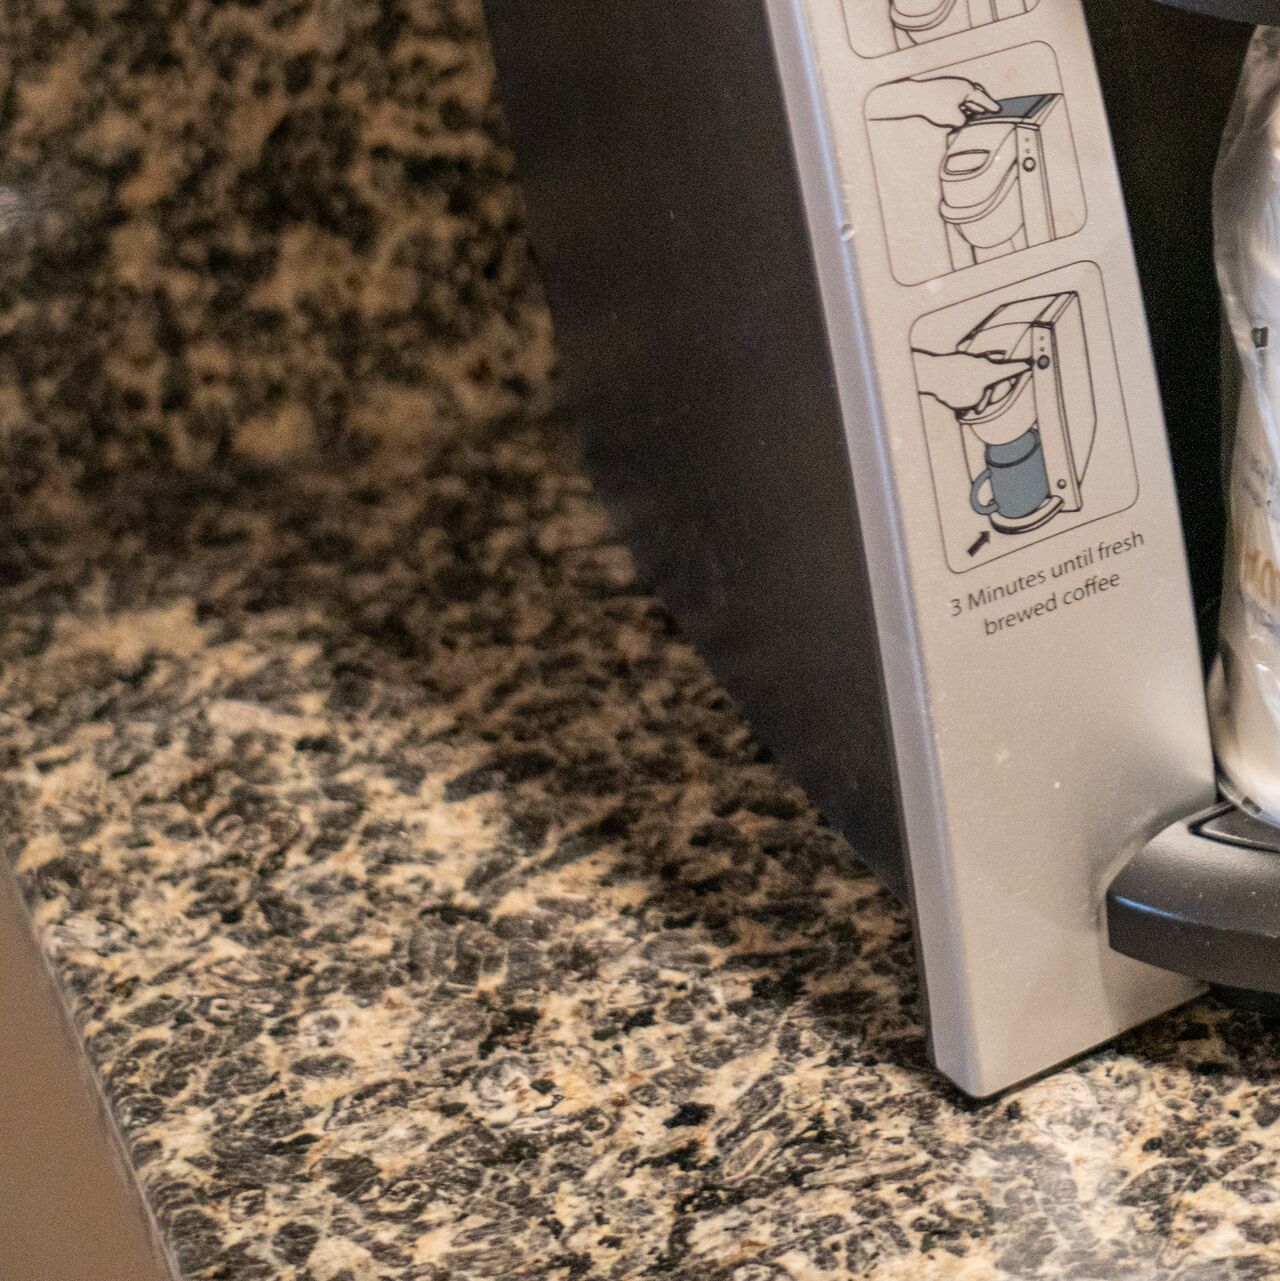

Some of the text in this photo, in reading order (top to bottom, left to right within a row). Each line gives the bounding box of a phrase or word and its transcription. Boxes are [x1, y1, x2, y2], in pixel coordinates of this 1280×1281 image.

[950, 530, 1145, 617] 3 Minutes until fresh
[984, 573, 1121, 636] brewed coffee
